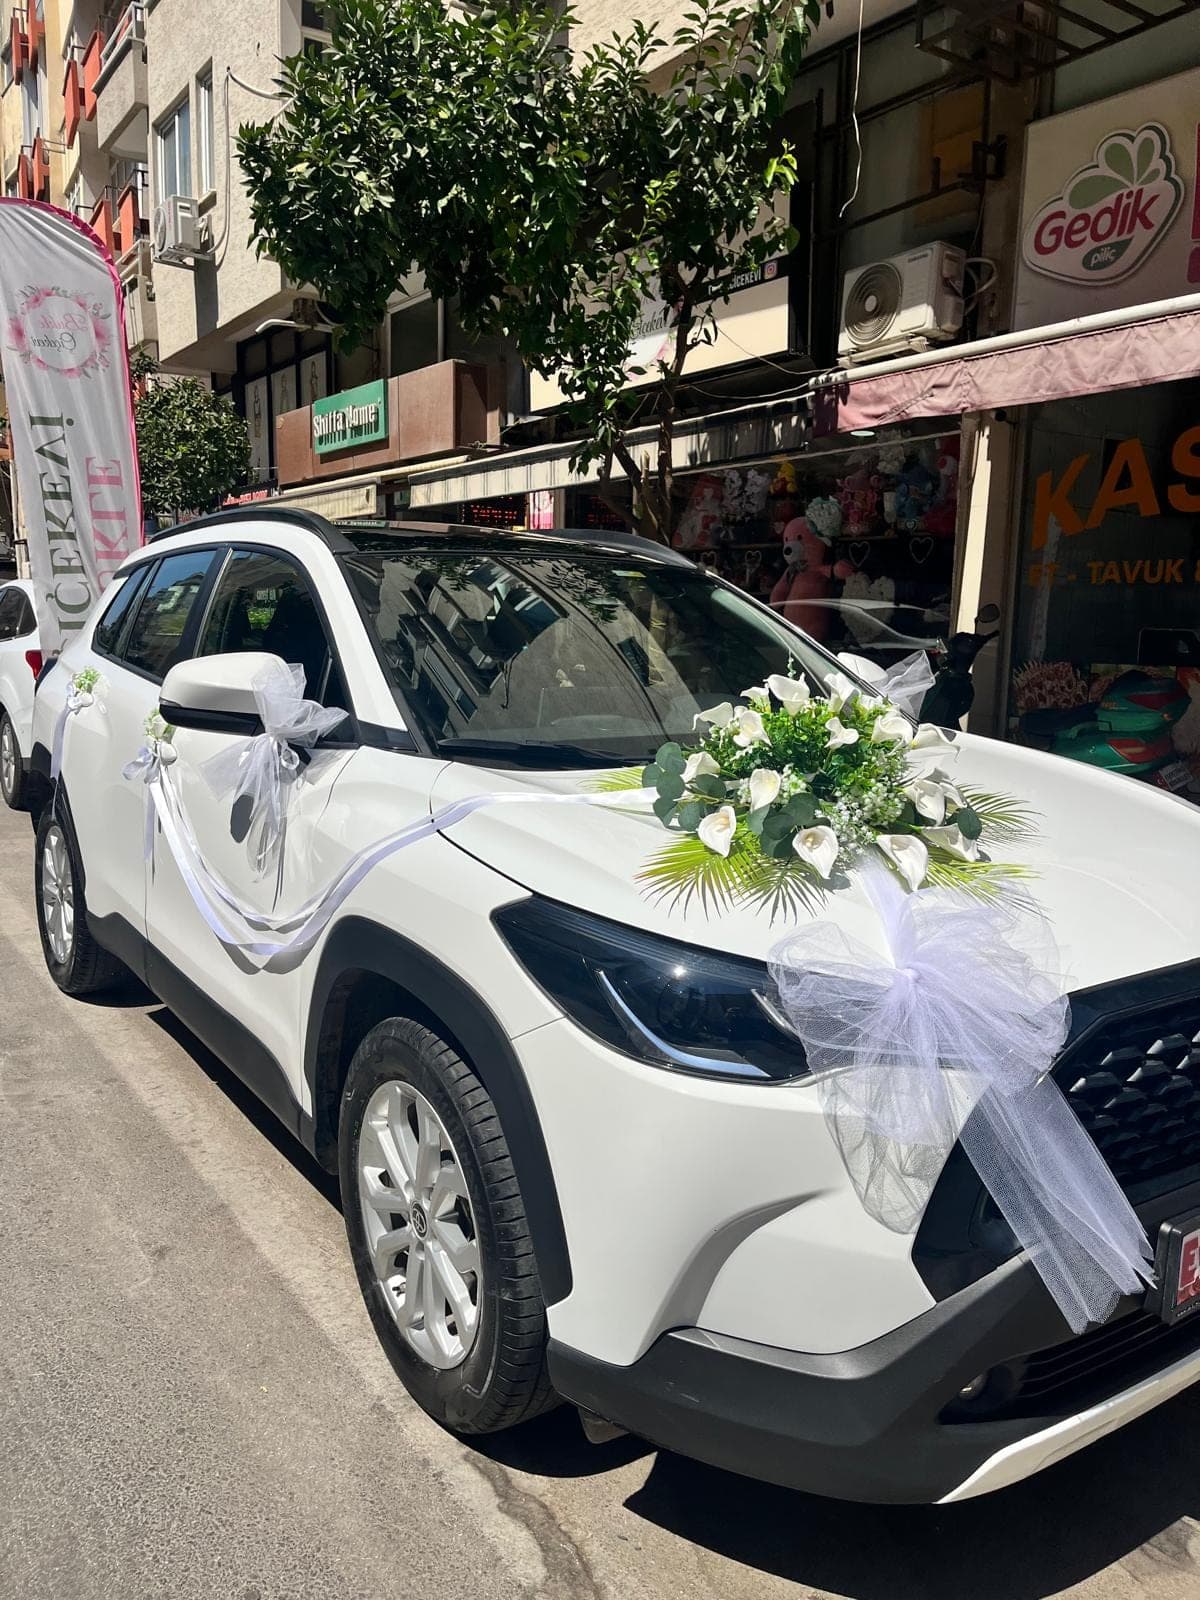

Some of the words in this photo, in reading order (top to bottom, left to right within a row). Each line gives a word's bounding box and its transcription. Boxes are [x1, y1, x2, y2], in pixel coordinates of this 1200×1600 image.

[1033, 187, 1161, 256] Gedik
[1090, 246, 1118, 268] piliç
[313, 411, 343, 438] Shiffa
[345, 403, 377, 428] Home
[1087, 560, 1184, 584] TAVUK
